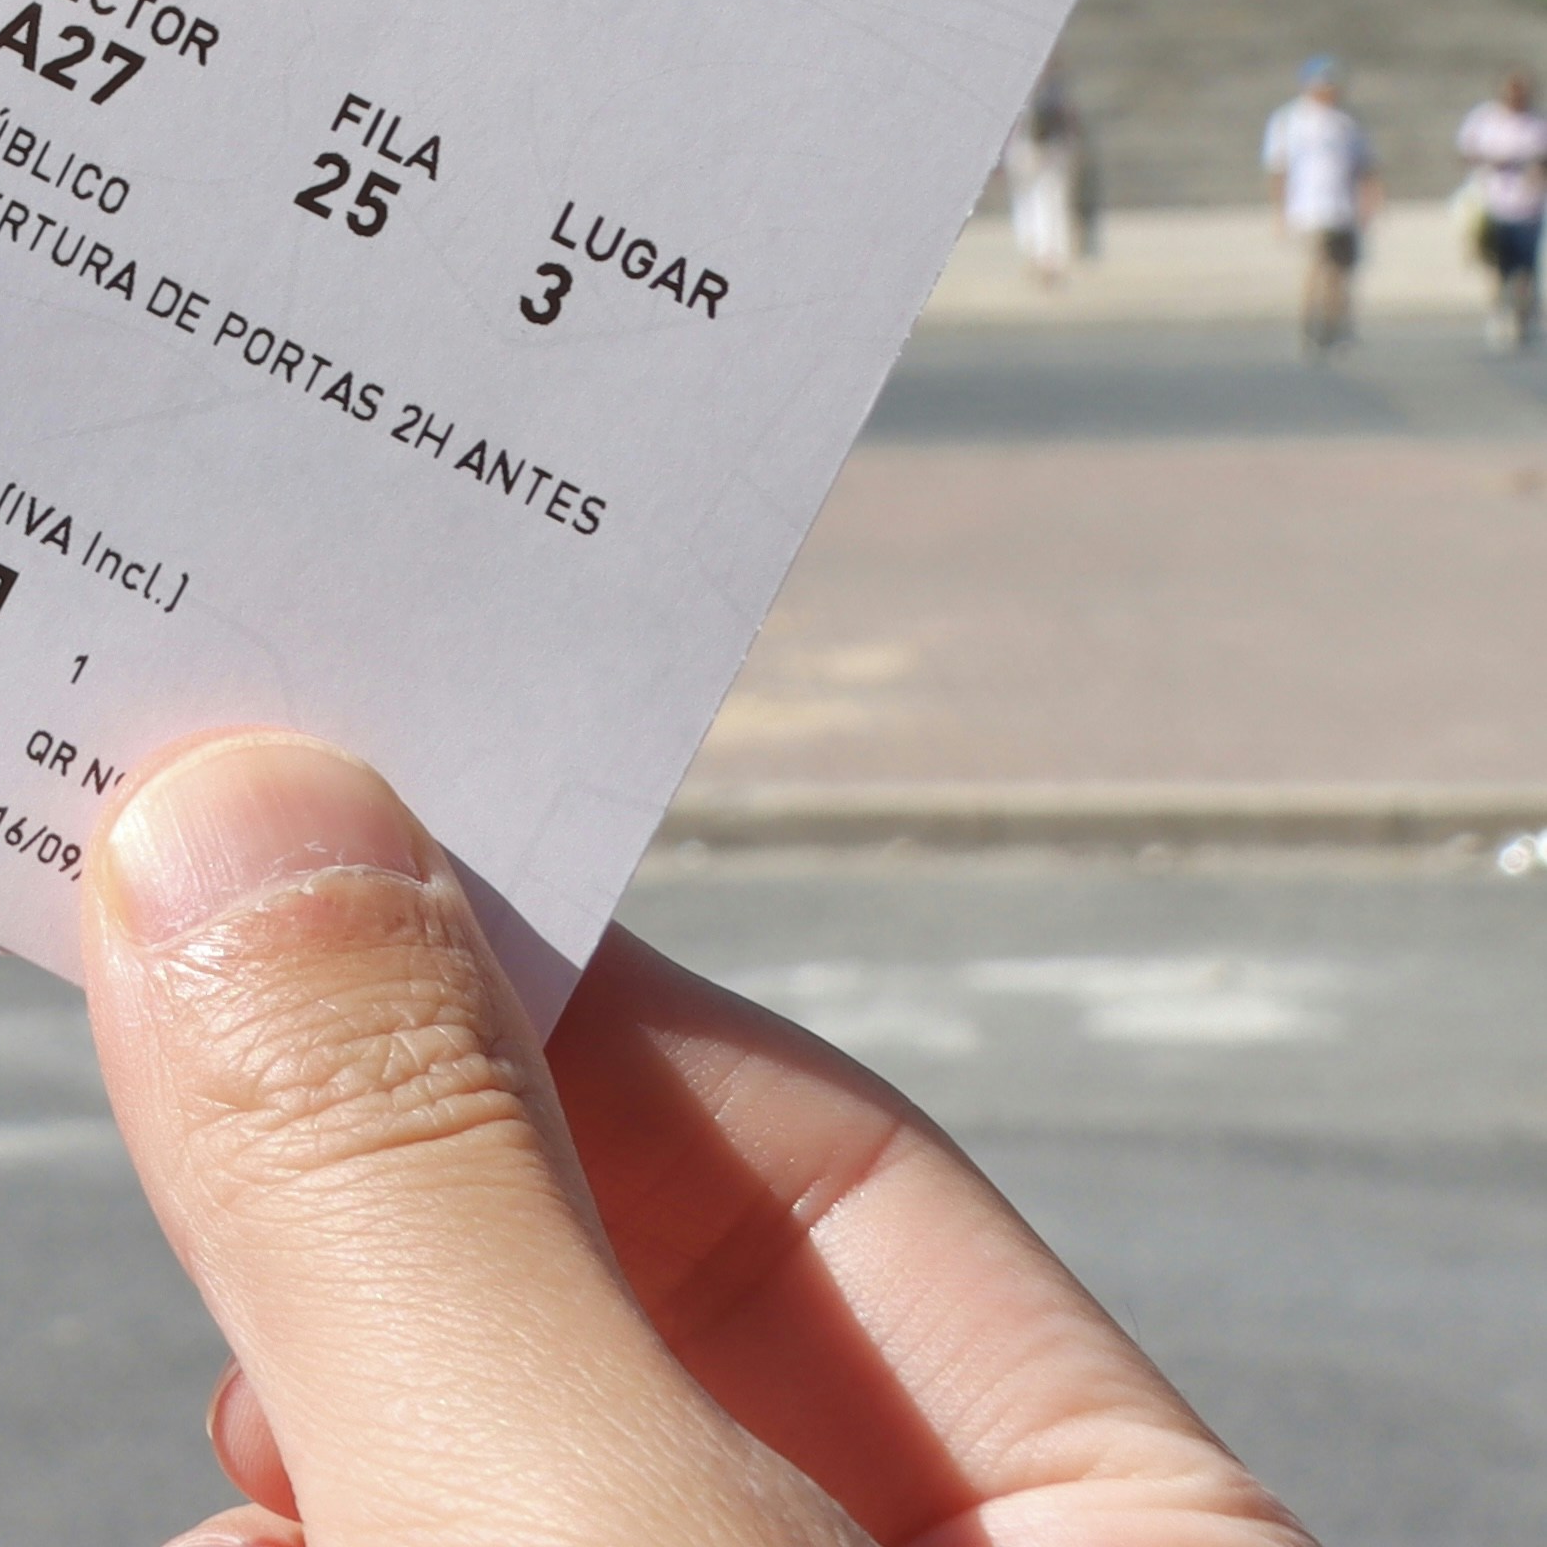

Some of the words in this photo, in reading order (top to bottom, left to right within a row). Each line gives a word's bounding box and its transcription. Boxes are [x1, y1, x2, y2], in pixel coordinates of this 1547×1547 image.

[330, 92, 441, 182] FILA
[293, 151, 402, 238] 25
[519, 261, 574, 326] 3
[549, 200, 730, 320] LUGAR
[145, 275, 211, 334] DE
[213, 310, 385, 422] PORTAS
[390, 403, 455, 459] 2H
[453, 438, 607, 536] ANTES
[81, 530, 190, 614] Incl.)
[70, 654, 89, 685] 1
[26, 729, 78, 777] QR
